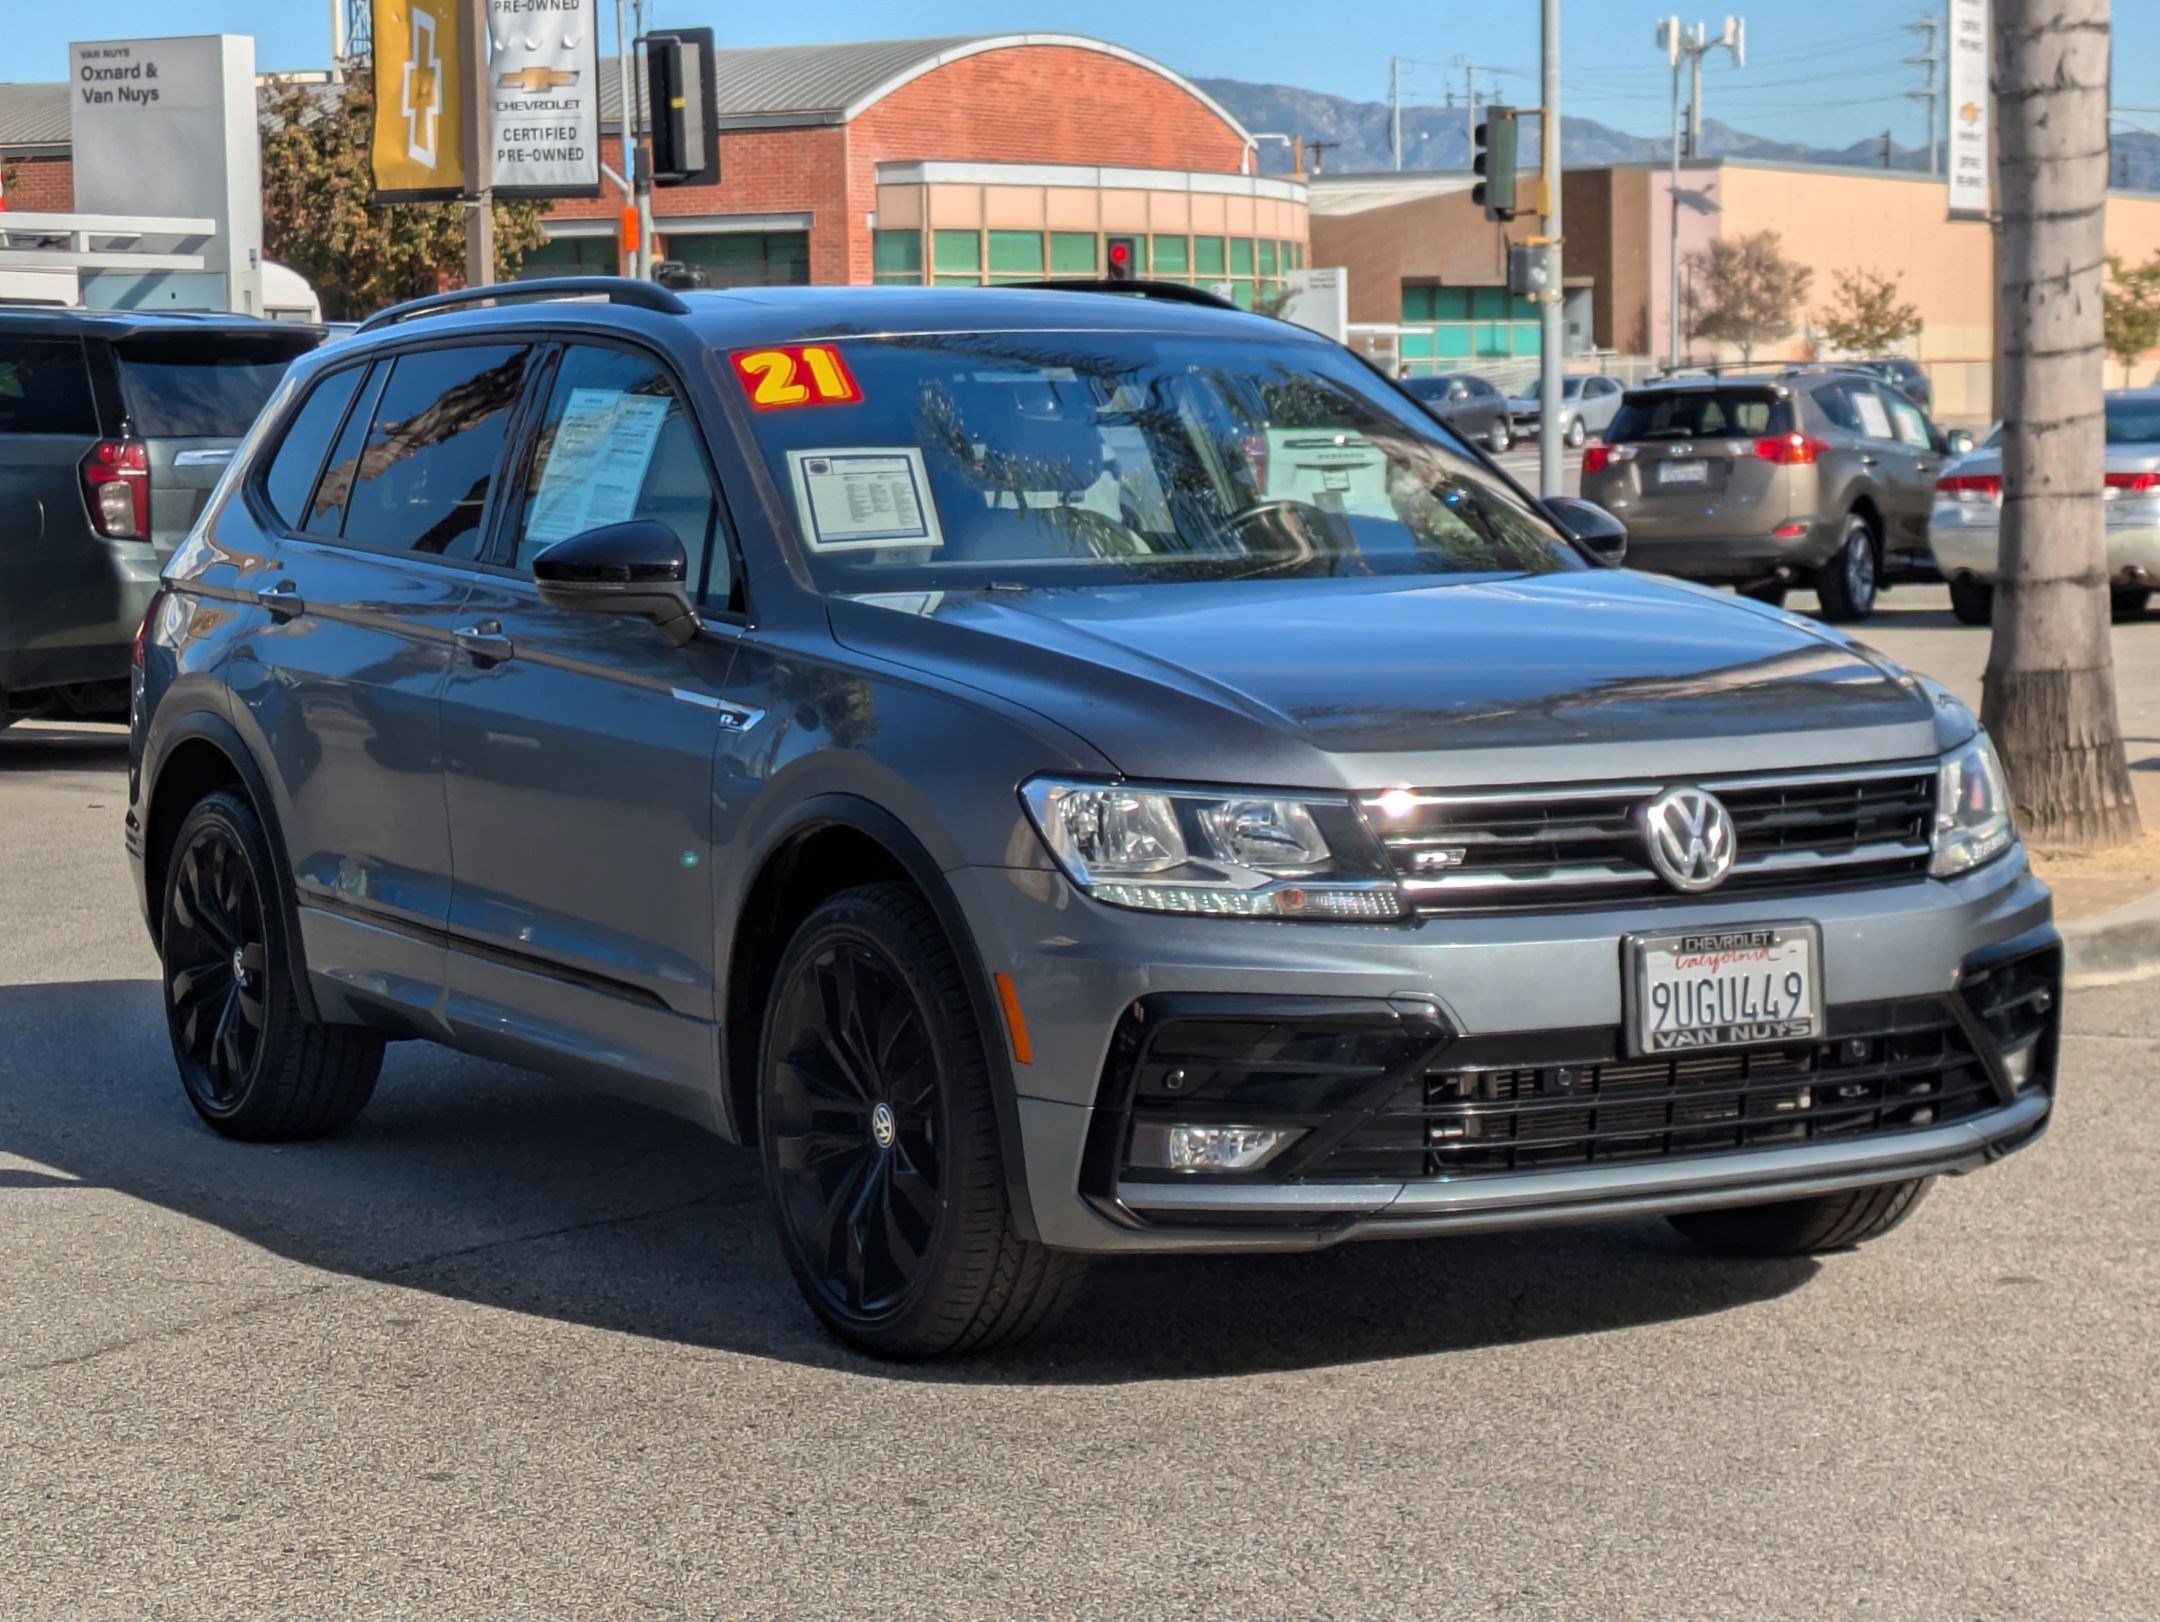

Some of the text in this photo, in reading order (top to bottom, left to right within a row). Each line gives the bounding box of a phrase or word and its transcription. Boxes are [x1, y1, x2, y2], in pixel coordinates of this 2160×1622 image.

[494, 0, 580, 12] PRE-OWNED
[81, 48, 130, 59] VAN NUYS
[81, 63, 158, 81] Oxnard &
[82, 87, 159, 106] Van Nuys
[496, 100, 581, 111] CHEVROLET
[503, 127, 577, 141] CERTIFIED
[498, 148, 584, 162] PRE-OWNED
[740, 348, 853, 406] 21
[1685, 933, 1771, 951] CHEVROLET
[1652, 971, 1803, 1030] 9UGU449
[1655, 1020, 1811, 1048] VAN NUYS
